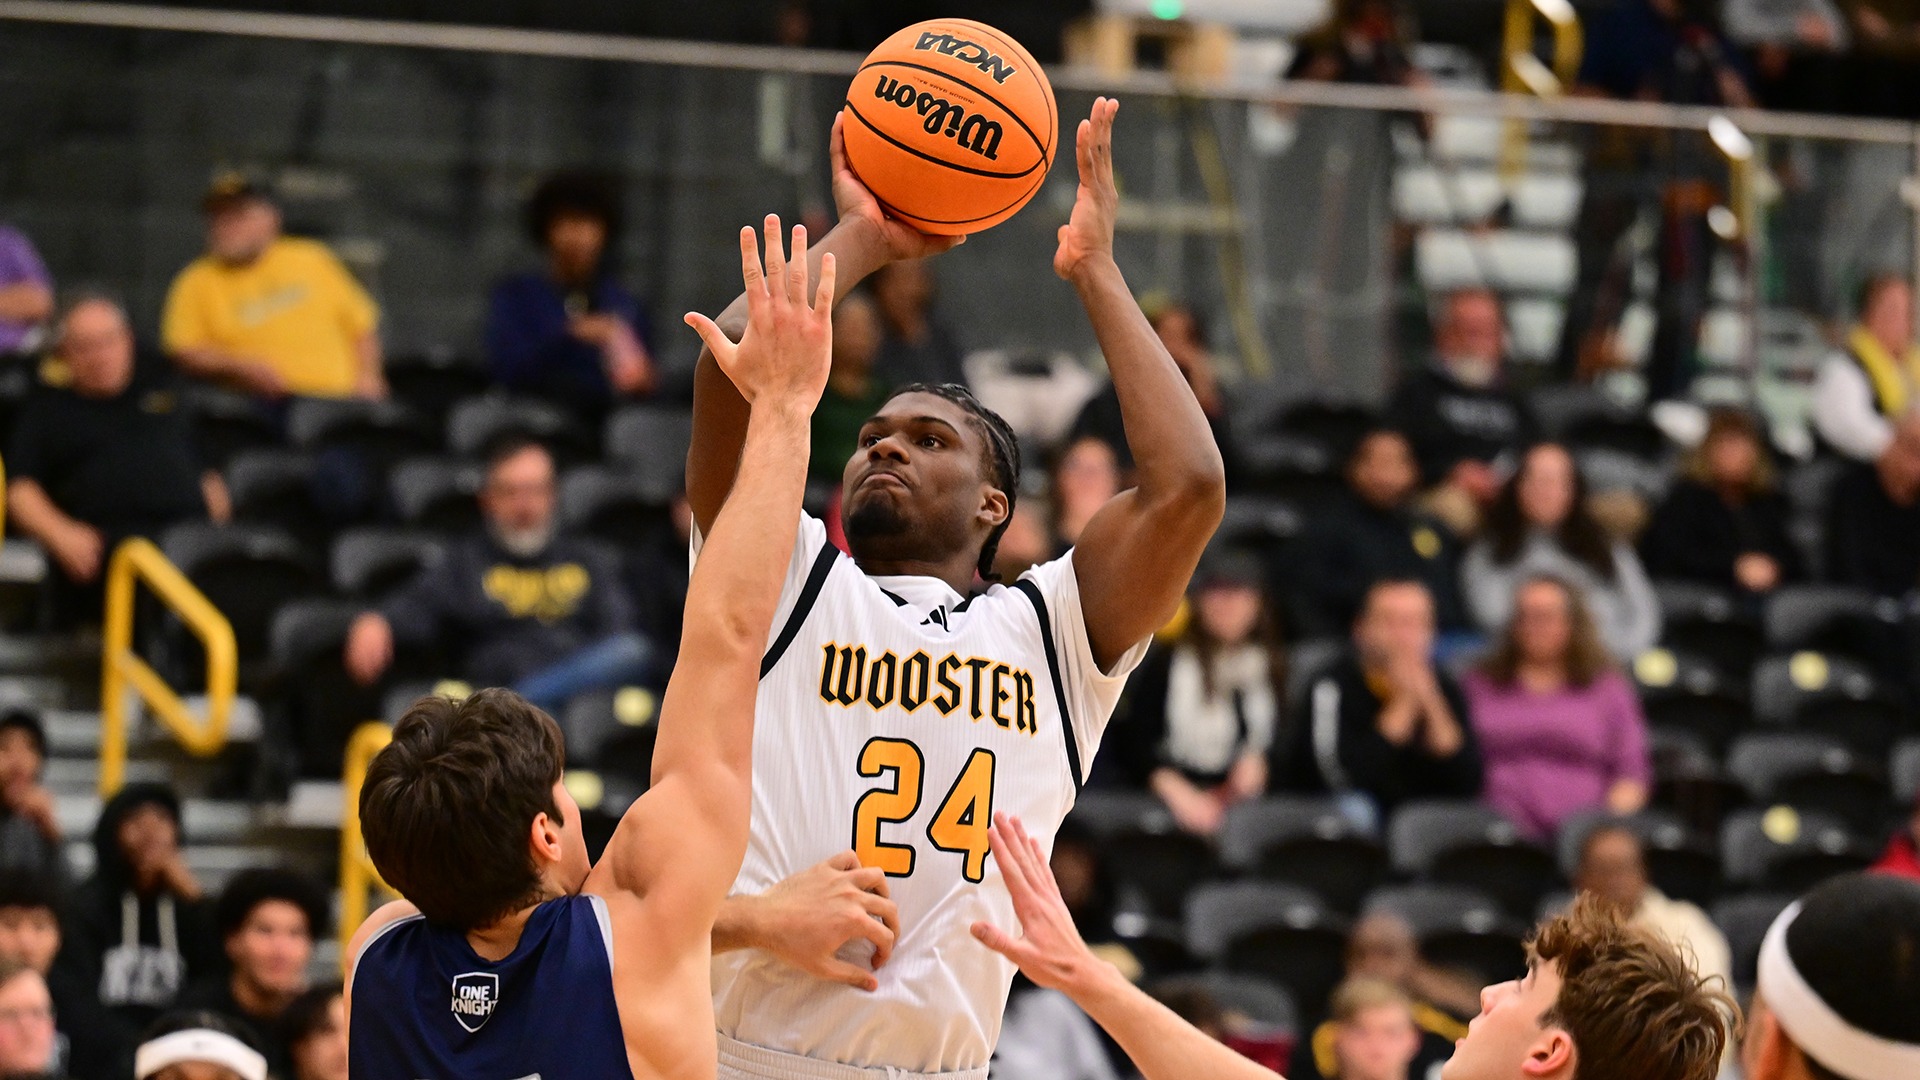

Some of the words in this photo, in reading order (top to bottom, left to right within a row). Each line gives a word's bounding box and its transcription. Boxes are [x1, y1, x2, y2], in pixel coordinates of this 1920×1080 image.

[915, 31, 1016, 84] NCAA
[874, 75, 1003, 160] Wilson
[819, 640, 1037, 738] WOOSTER
[851, 736, 997, 884] 24
[459, 985, 491, 1001] ONE
